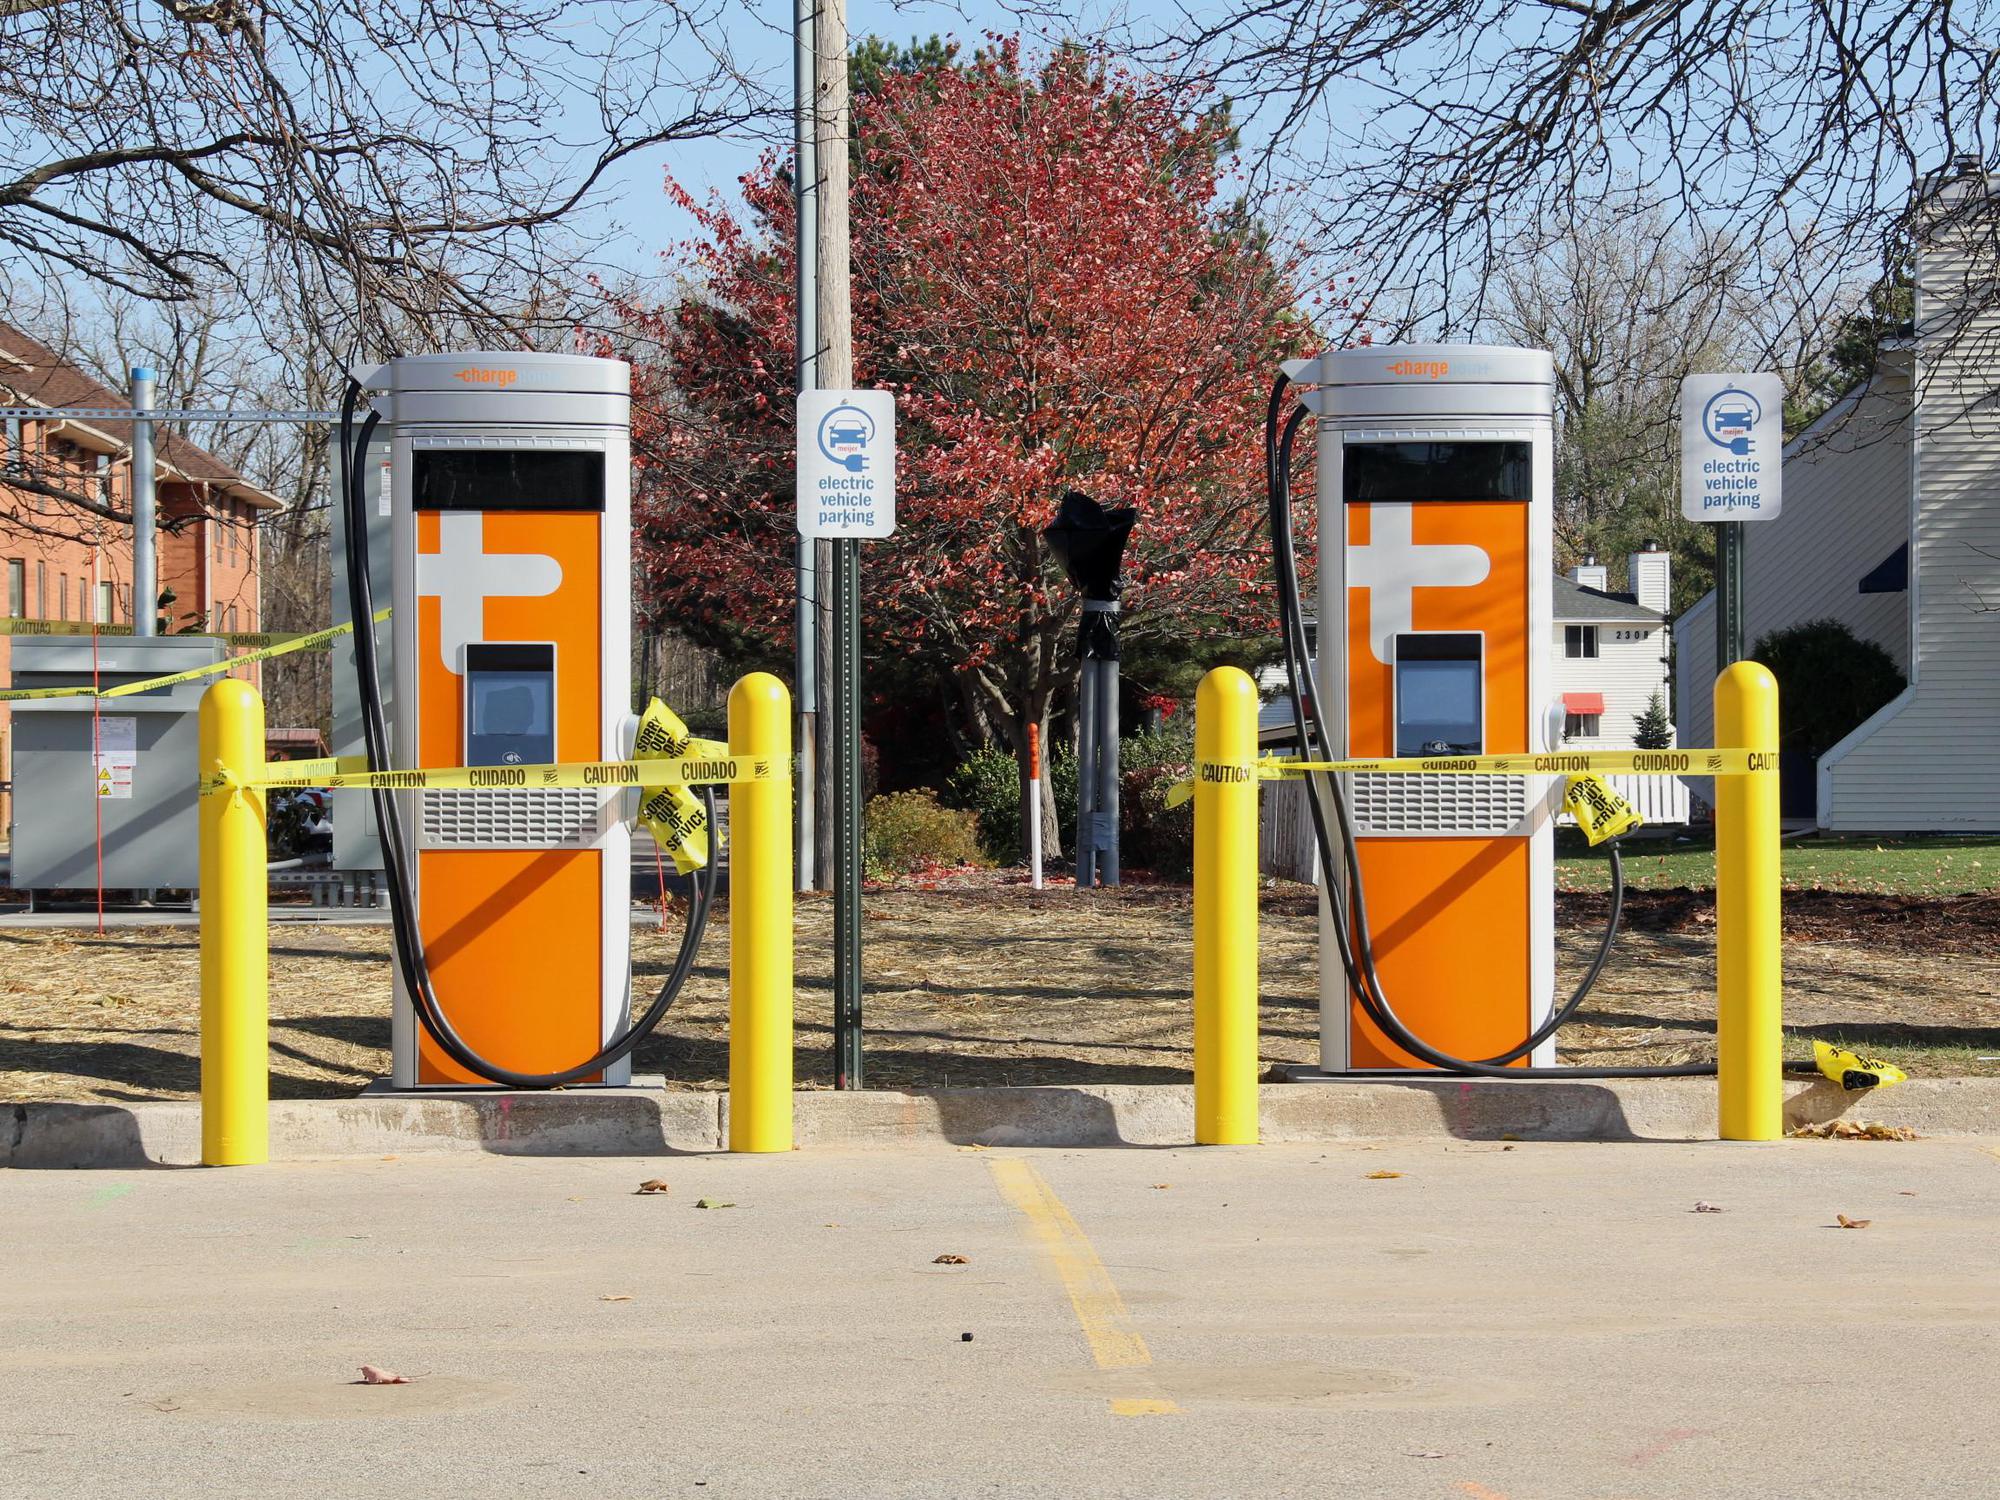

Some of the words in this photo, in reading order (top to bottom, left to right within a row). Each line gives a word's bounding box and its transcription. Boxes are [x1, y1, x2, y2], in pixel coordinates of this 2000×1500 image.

[1722, 428, 1744, 436] meijer
[837, 445, 858, 453] meijer
[1703, 459, 1760, 473] electric
[818, 475, 874, 490] electric
[1705, 475, 1757, 489] vehicle
[820, 492, 872, 506] vehicle
[1703, 492, 1760, 510] parking
[818, 508, 874, 527] parking
[637, 716, 662, 753] SORRY
[650, 727, 670, 752] OUT
[662, 737, 676, 755] OF
[1535, 756, 1590, 772] CAUTION
[1632, 754, 1689, 771] CUIDADO
[371, 772, 426, 788] CAUTION
[469, 769, 526, 786] CUIDADO
[583, 765, 639, 783] CAUTION
[681, 761, 737, 780] CUIDADO
[1201, 765, 1250, 783] CAUTION
[1582, 783, 1602, 805] OUT
[1593, 793, 1609, 811] OF
[643, 787, 674, 820] SORRY
[656, 801, 678, 823] OUT
[668, 812, 683, 829] OF
[1592, 796, 1625, 830] SERVIC
[666, 809, 706, 851] SERVICE
